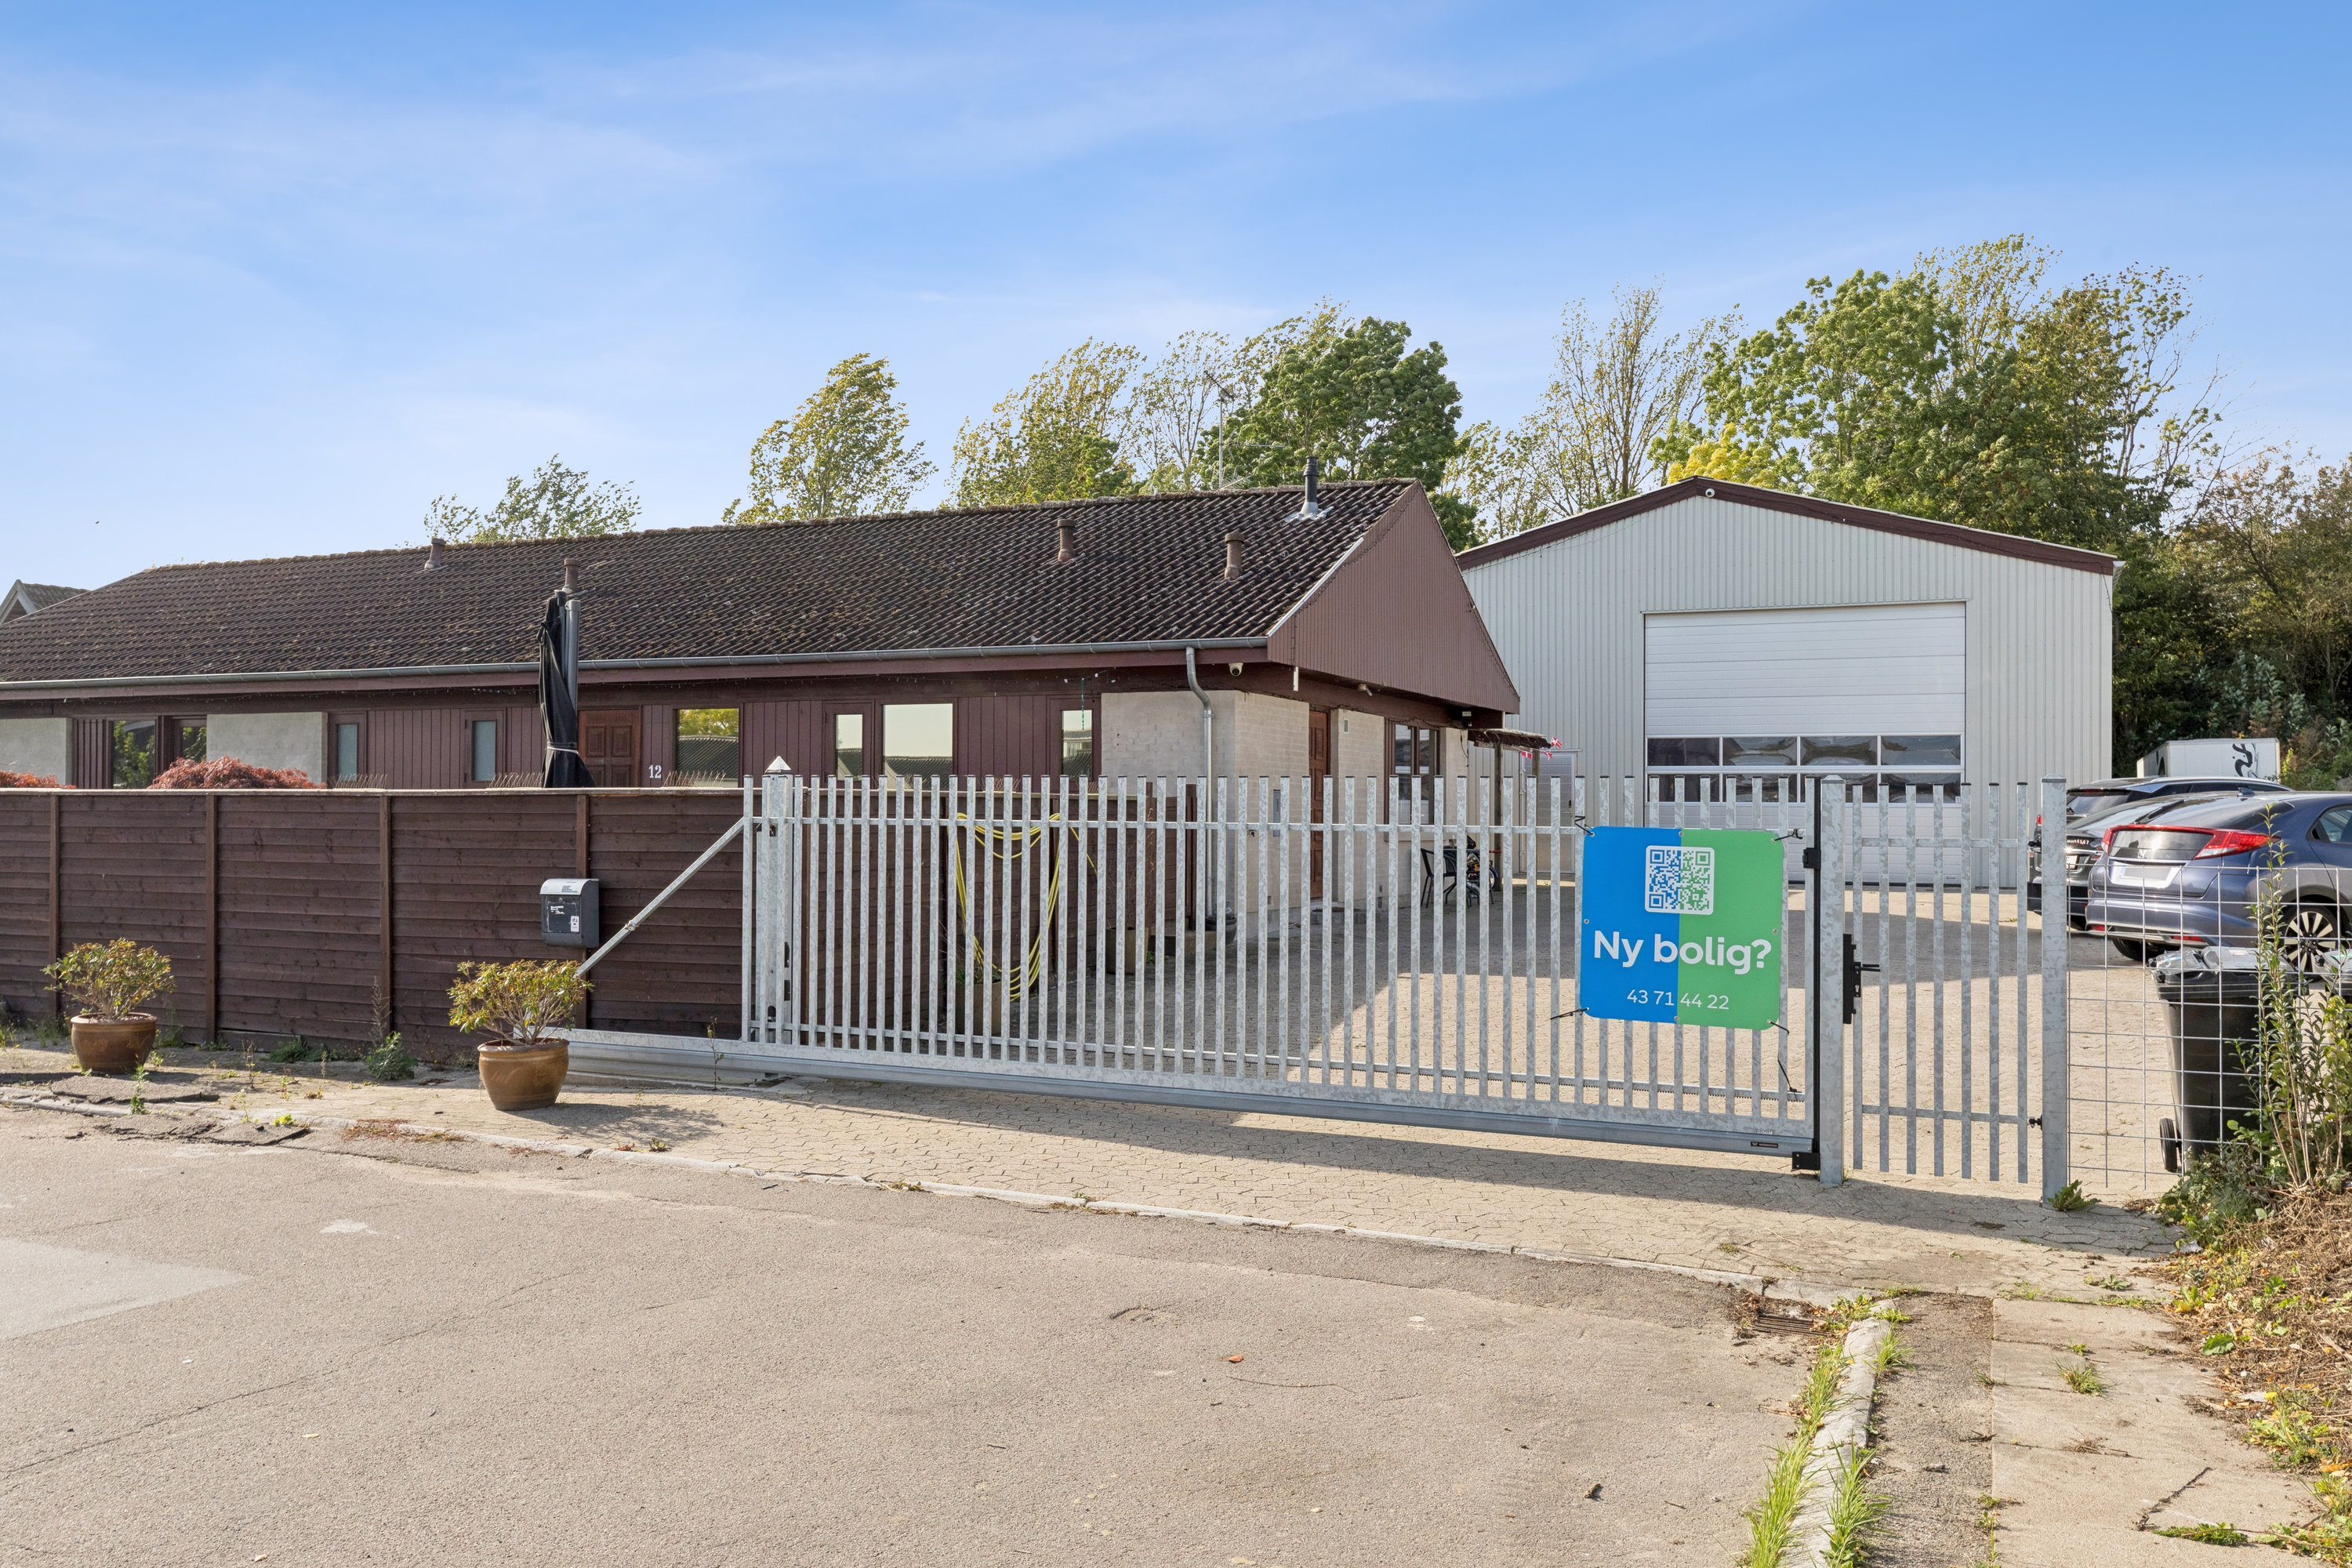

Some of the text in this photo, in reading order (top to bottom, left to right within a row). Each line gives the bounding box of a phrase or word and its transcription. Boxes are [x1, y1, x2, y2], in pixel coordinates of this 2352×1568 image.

[648, 764, 662, 779] 12
[1594, 930, 1772, 975] Ny bolig?
[1627, 989, 1730, 1010] 43 71 44 22
